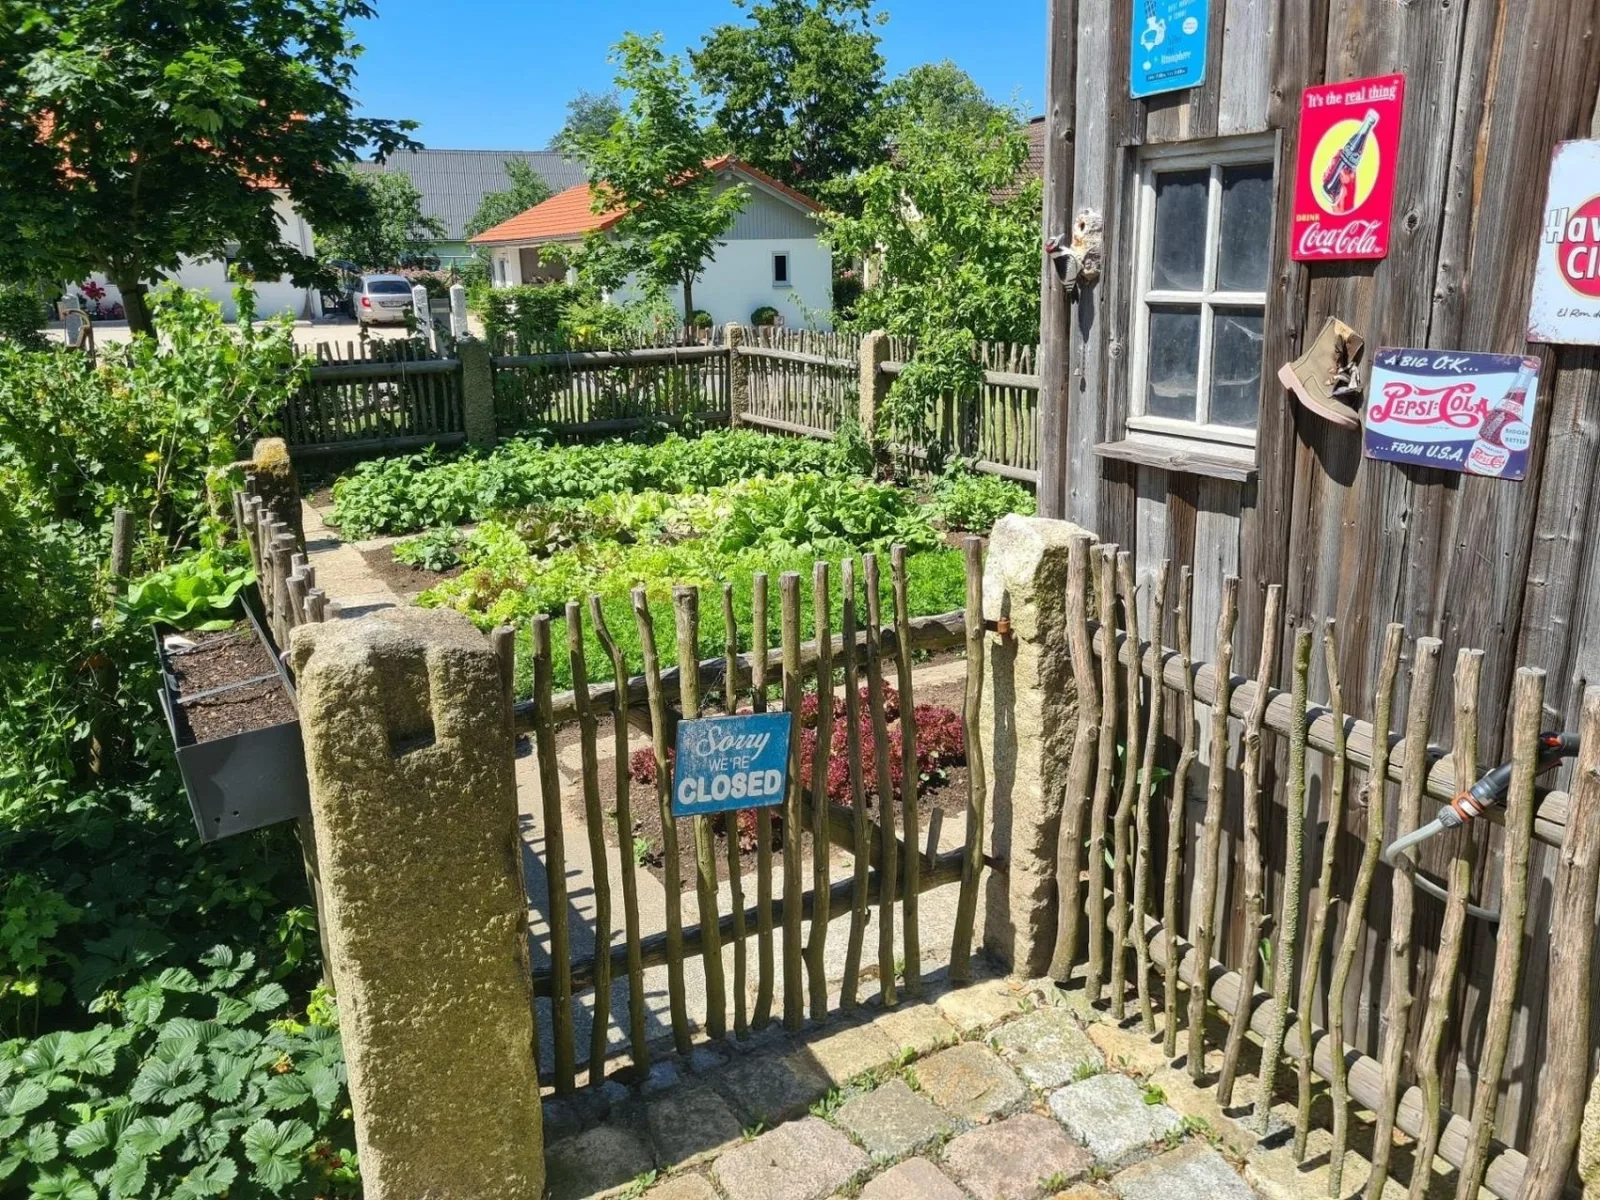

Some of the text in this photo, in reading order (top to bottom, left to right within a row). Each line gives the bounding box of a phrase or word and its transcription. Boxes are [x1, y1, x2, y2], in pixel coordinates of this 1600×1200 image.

[1325, 91, 1342, 106] the
[1344, 86, 1366, 105] real
[1296, 214, 1320, 222] DRINK
[1296, 219, 1383, 255] Coca-Cola
[1567, 246, 1600, 280] Cl
[1385, 356, 1398, 366] A
[1400, 356, 1428, 368] BIG
[1426, 444, 1464, 463] U.S.A.
[696, 725, 771, 760] Sorry
[709, 755, 750, 772] WE'RE
[678, 769, 782, 805] CLOSED
